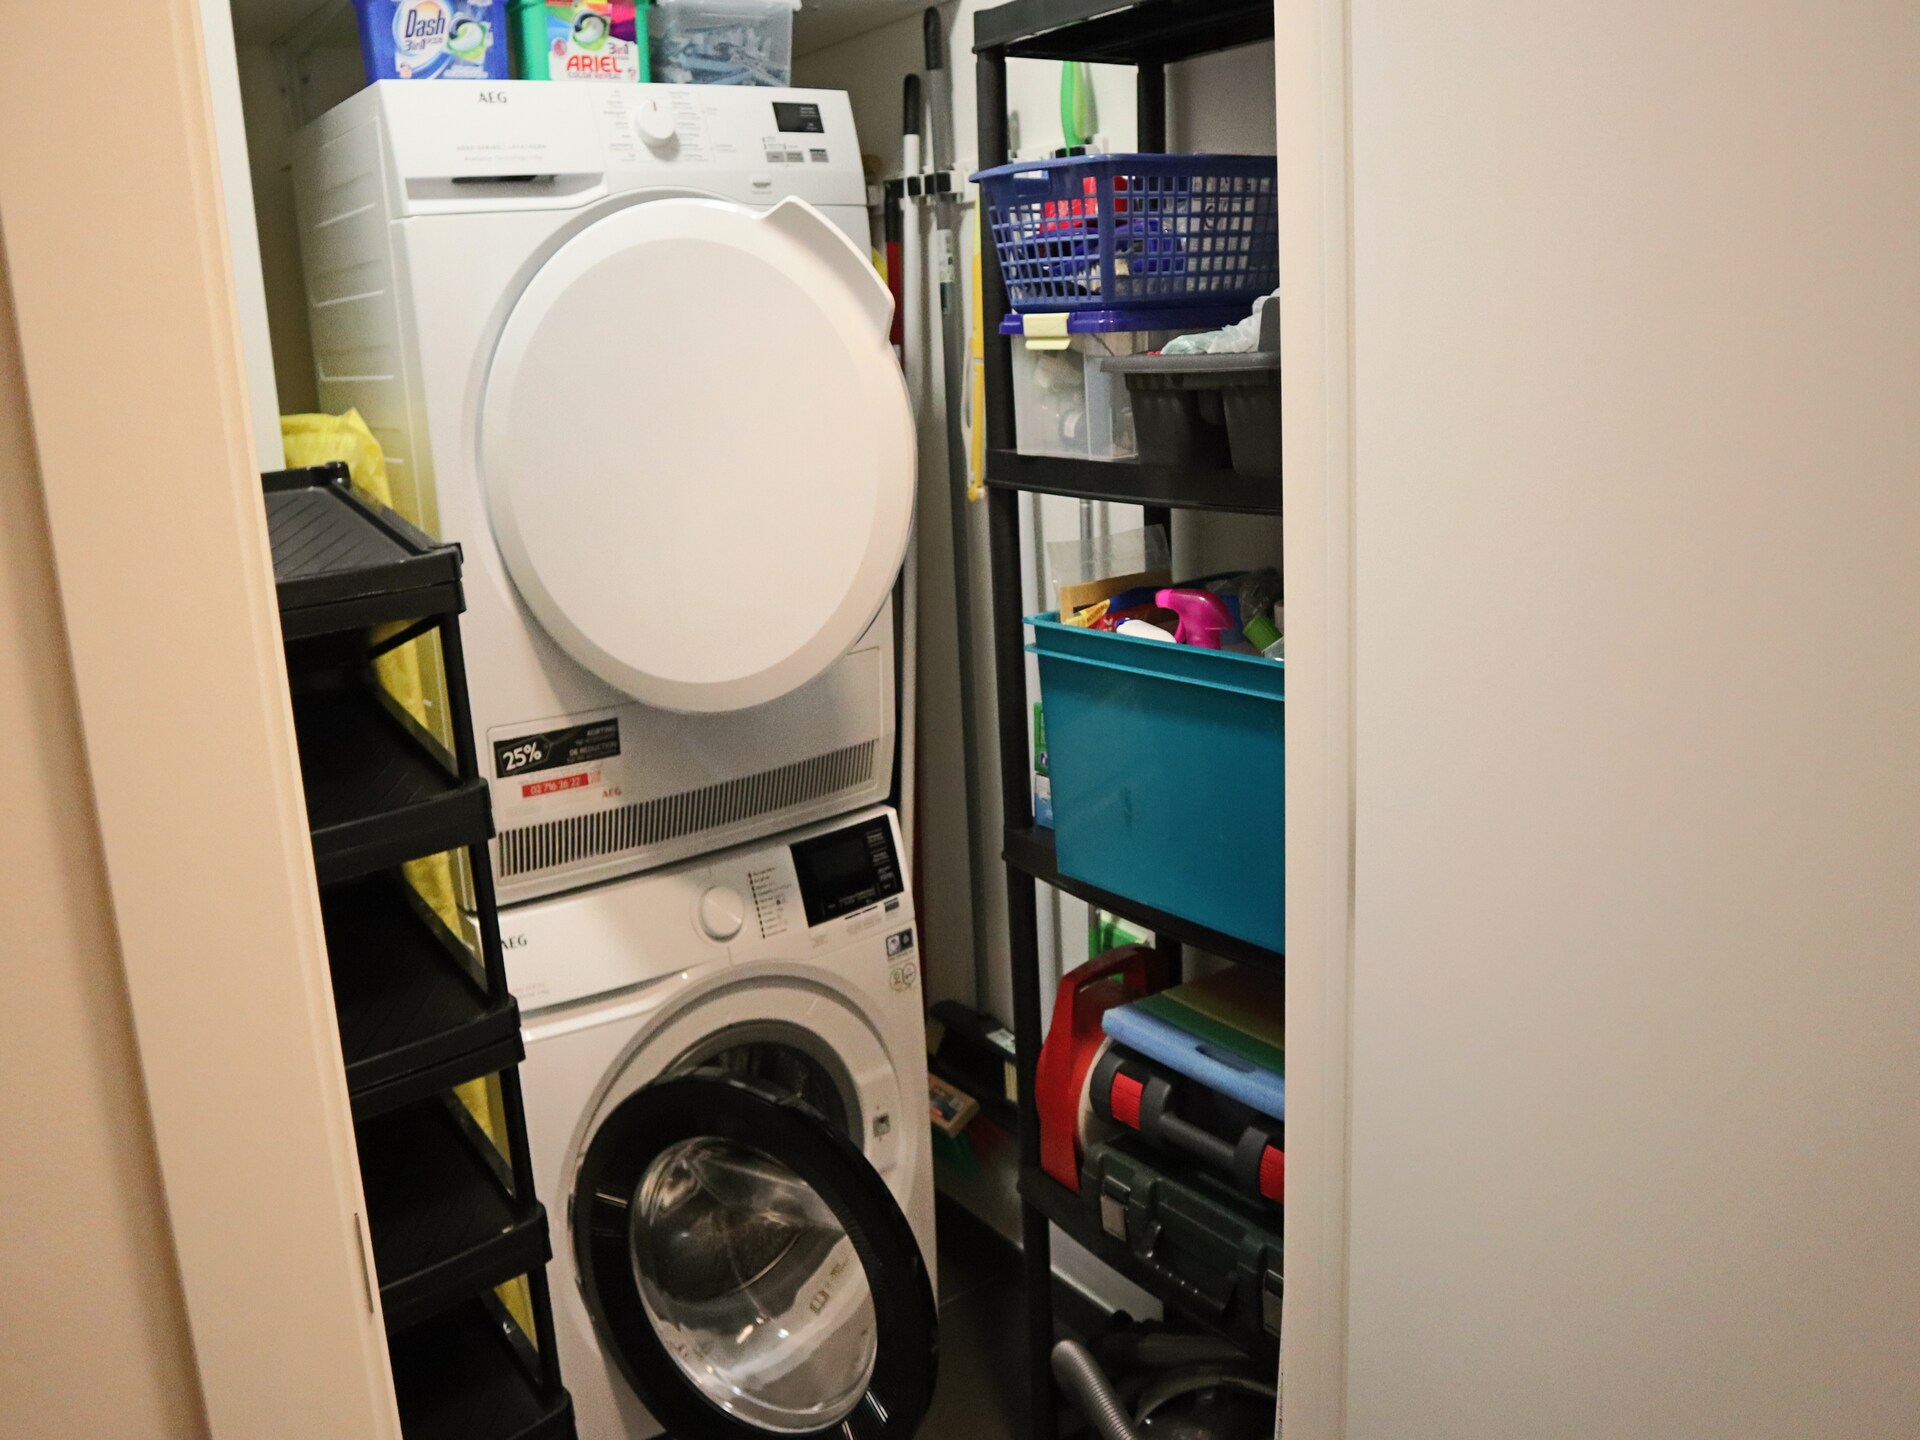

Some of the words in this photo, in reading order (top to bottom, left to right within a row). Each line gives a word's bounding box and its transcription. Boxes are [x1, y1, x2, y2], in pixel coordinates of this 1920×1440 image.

[404, 9, 446, 38] Dash
[566, 54, 623, 73] ARIEL
[479, 91, 508, 104] AEG
[502, 741, 542, 772] 25%
[602, 786, 622, 799] AEG
